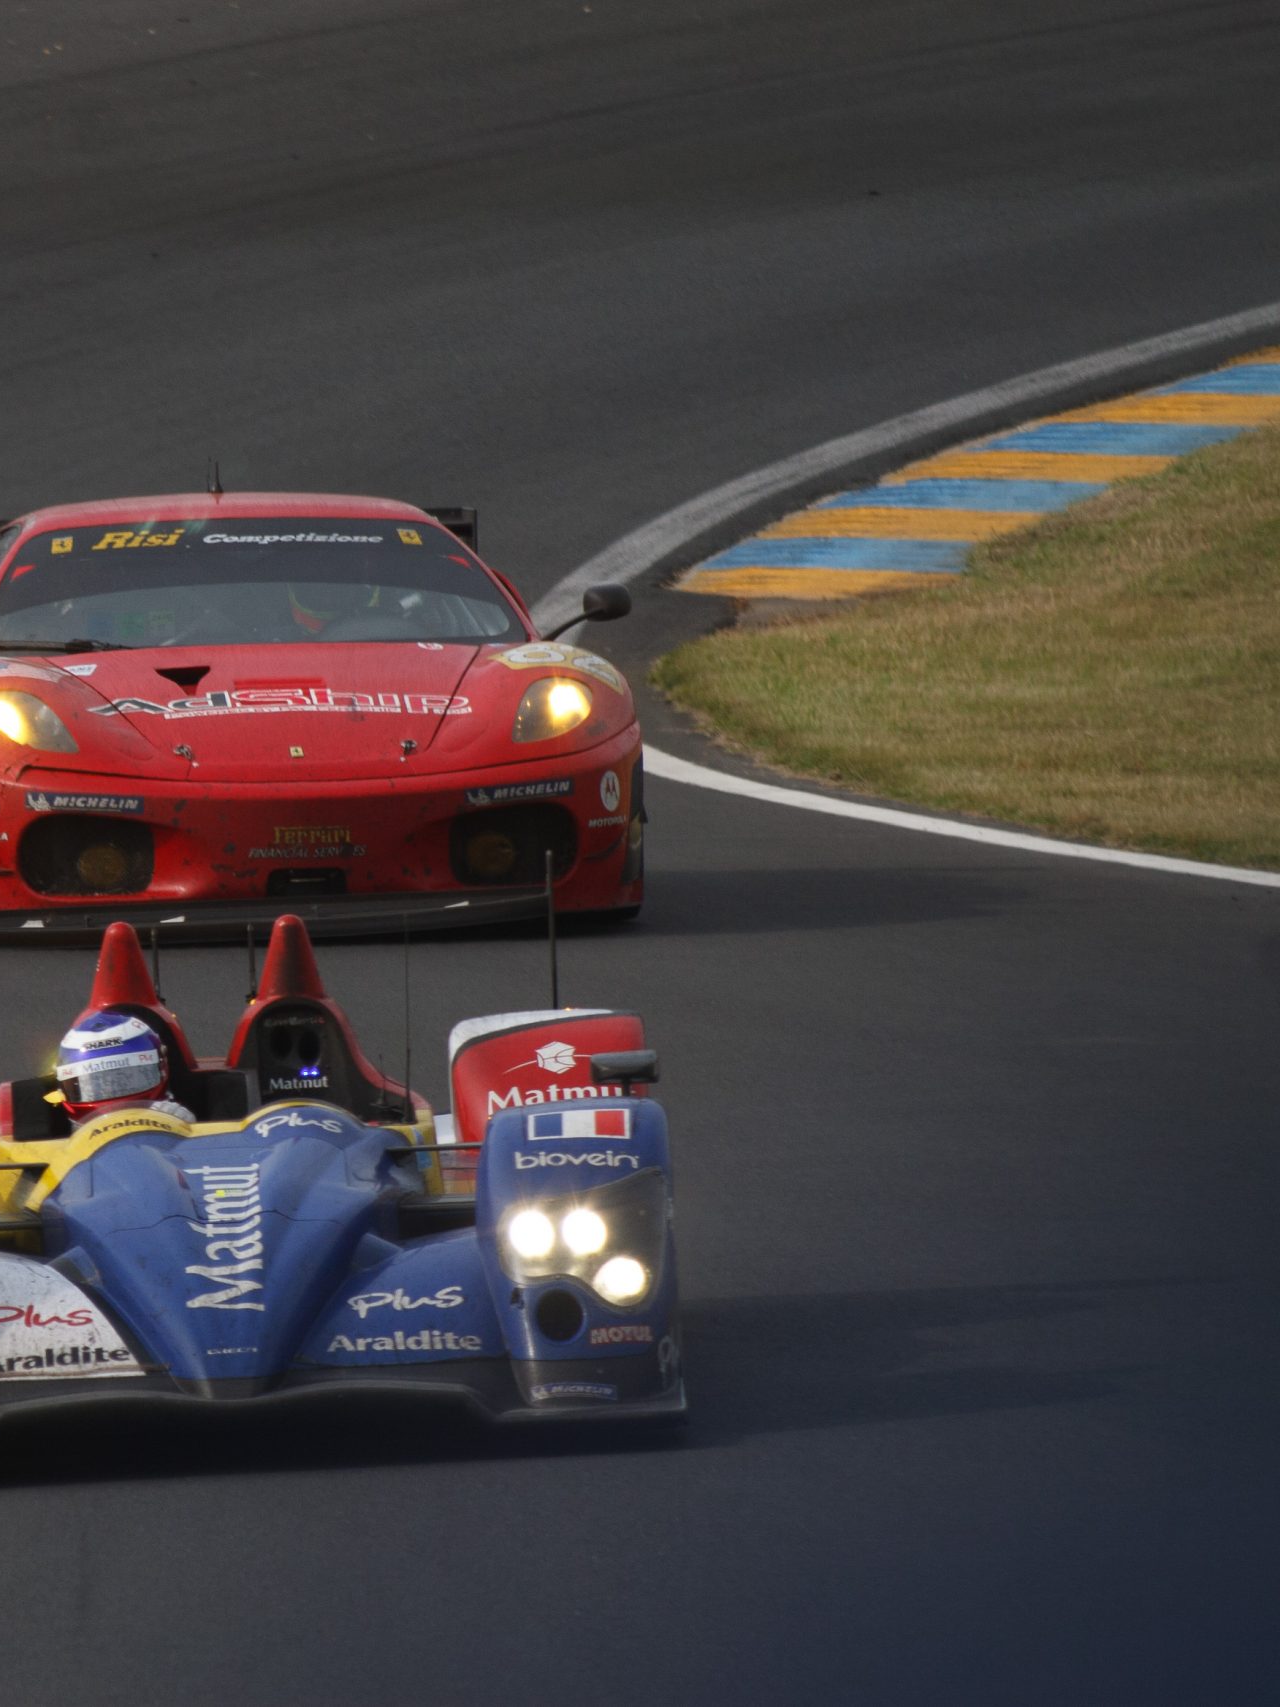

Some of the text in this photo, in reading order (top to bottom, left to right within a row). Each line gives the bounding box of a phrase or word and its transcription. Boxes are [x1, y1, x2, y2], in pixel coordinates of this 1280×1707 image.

[91, 528, 384, 550] Risi Competizione
[493, 780, 570, 800] MICHELIN
[52, 796, 139, 810] MICHELIN
[313, 844, 368, 858] SERVES
[269, 1075, 329, 1090] Matmut
[88, 1119, 173, 1141] Araldite
[253, 1112, 344, 1138] Plus
[515, 1150, 639, 1170] biovein
[182, 1163, 266, 1312] Matmut
[347, 1286, 465, 1319] Plus
[325, 1330, 483, 1353] Araldite
[589, 1325, 654, 1345] MOTUL
[551, 1384, 614, 1396] MICHELIN
